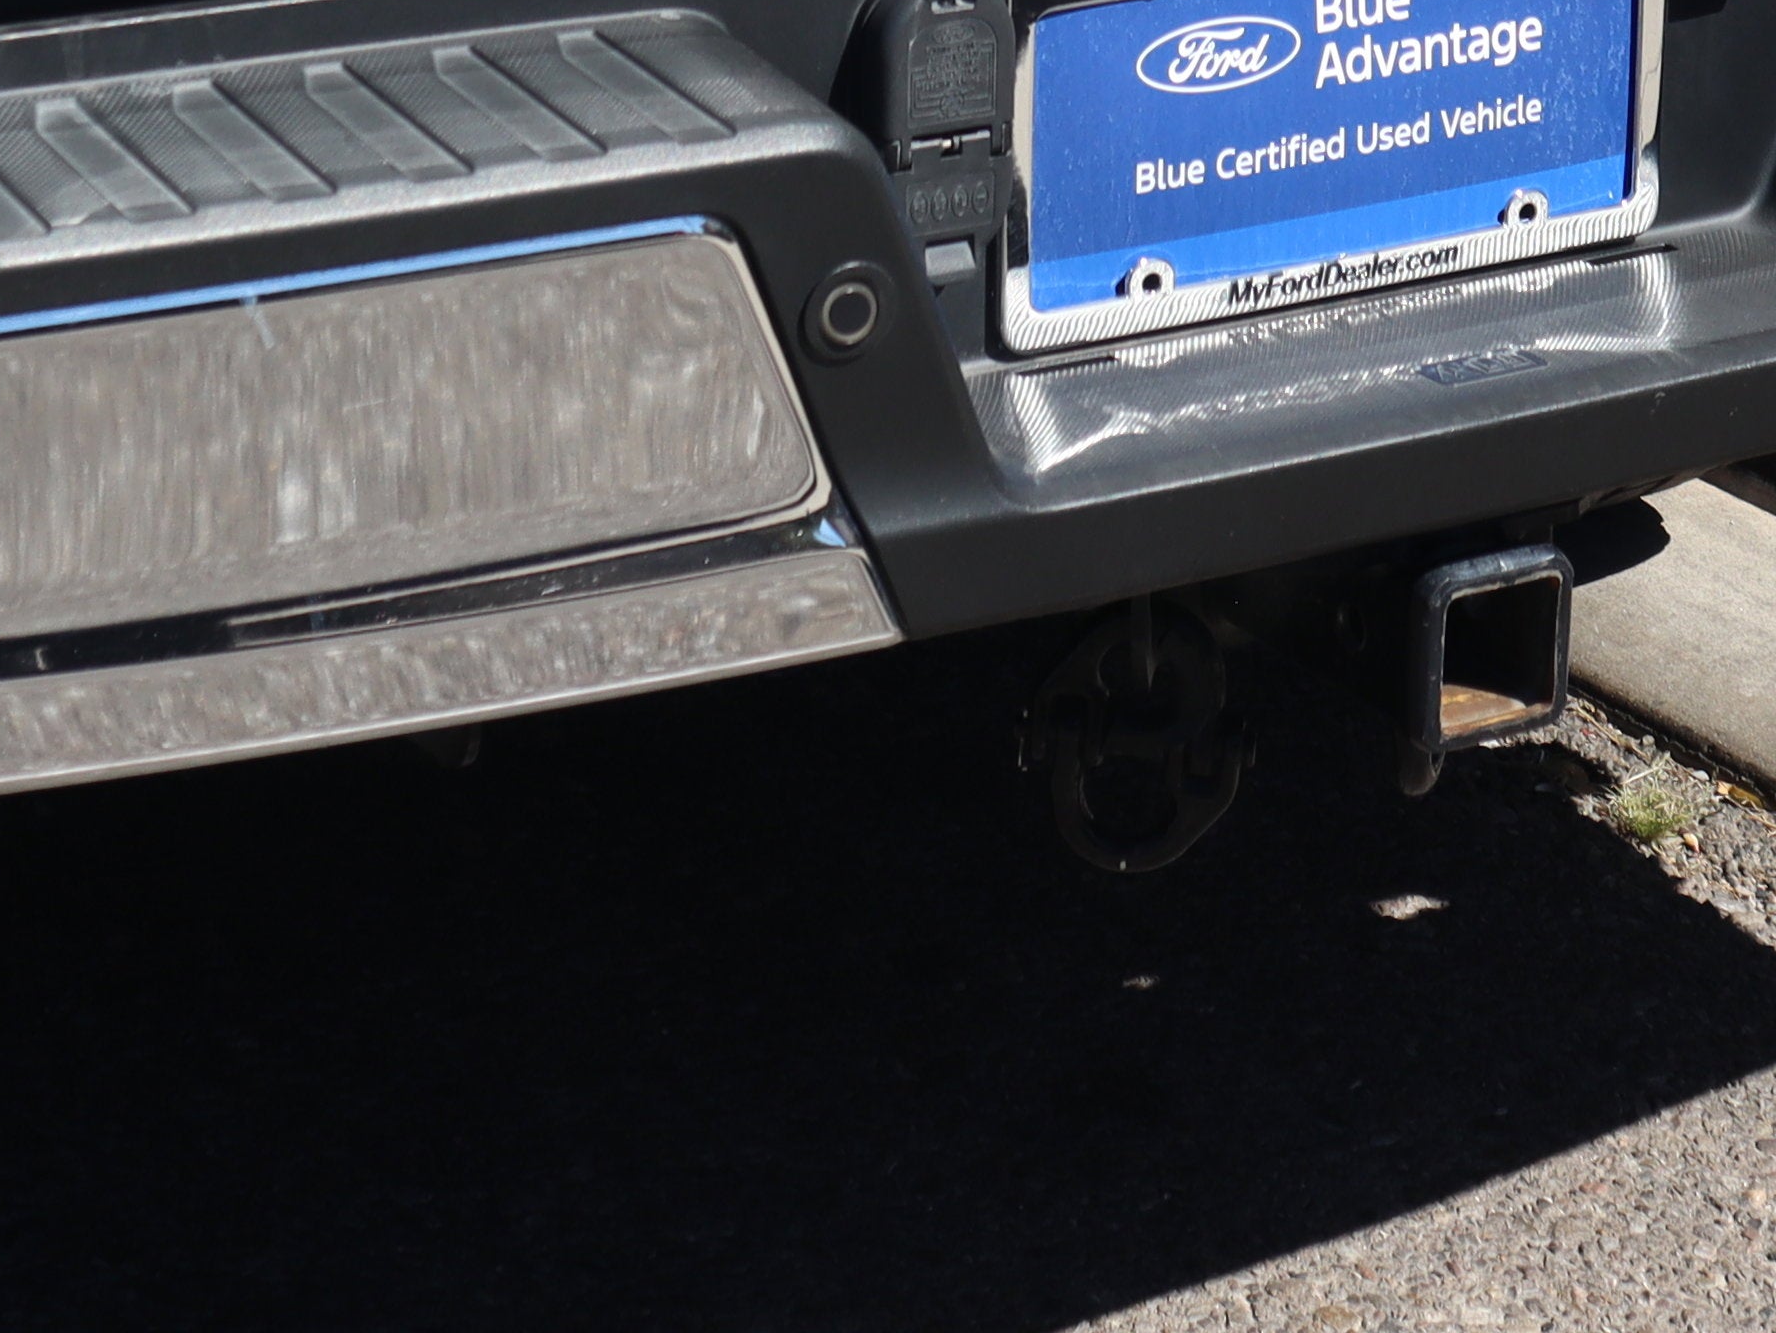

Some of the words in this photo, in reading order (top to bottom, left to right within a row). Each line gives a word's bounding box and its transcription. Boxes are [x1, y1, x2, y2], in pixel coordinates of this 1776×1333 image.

[1314, 14, 1544, 90] Advantage
[1134, 158, 1206, 195] Blue
[1216, 129, 1345, 180] Certified
[1356, 112, 1430, 156] Used
[1441, 93, 1543, 141] Vehicle
[1228, 244, 1459, 307] MyFordDealer.com
